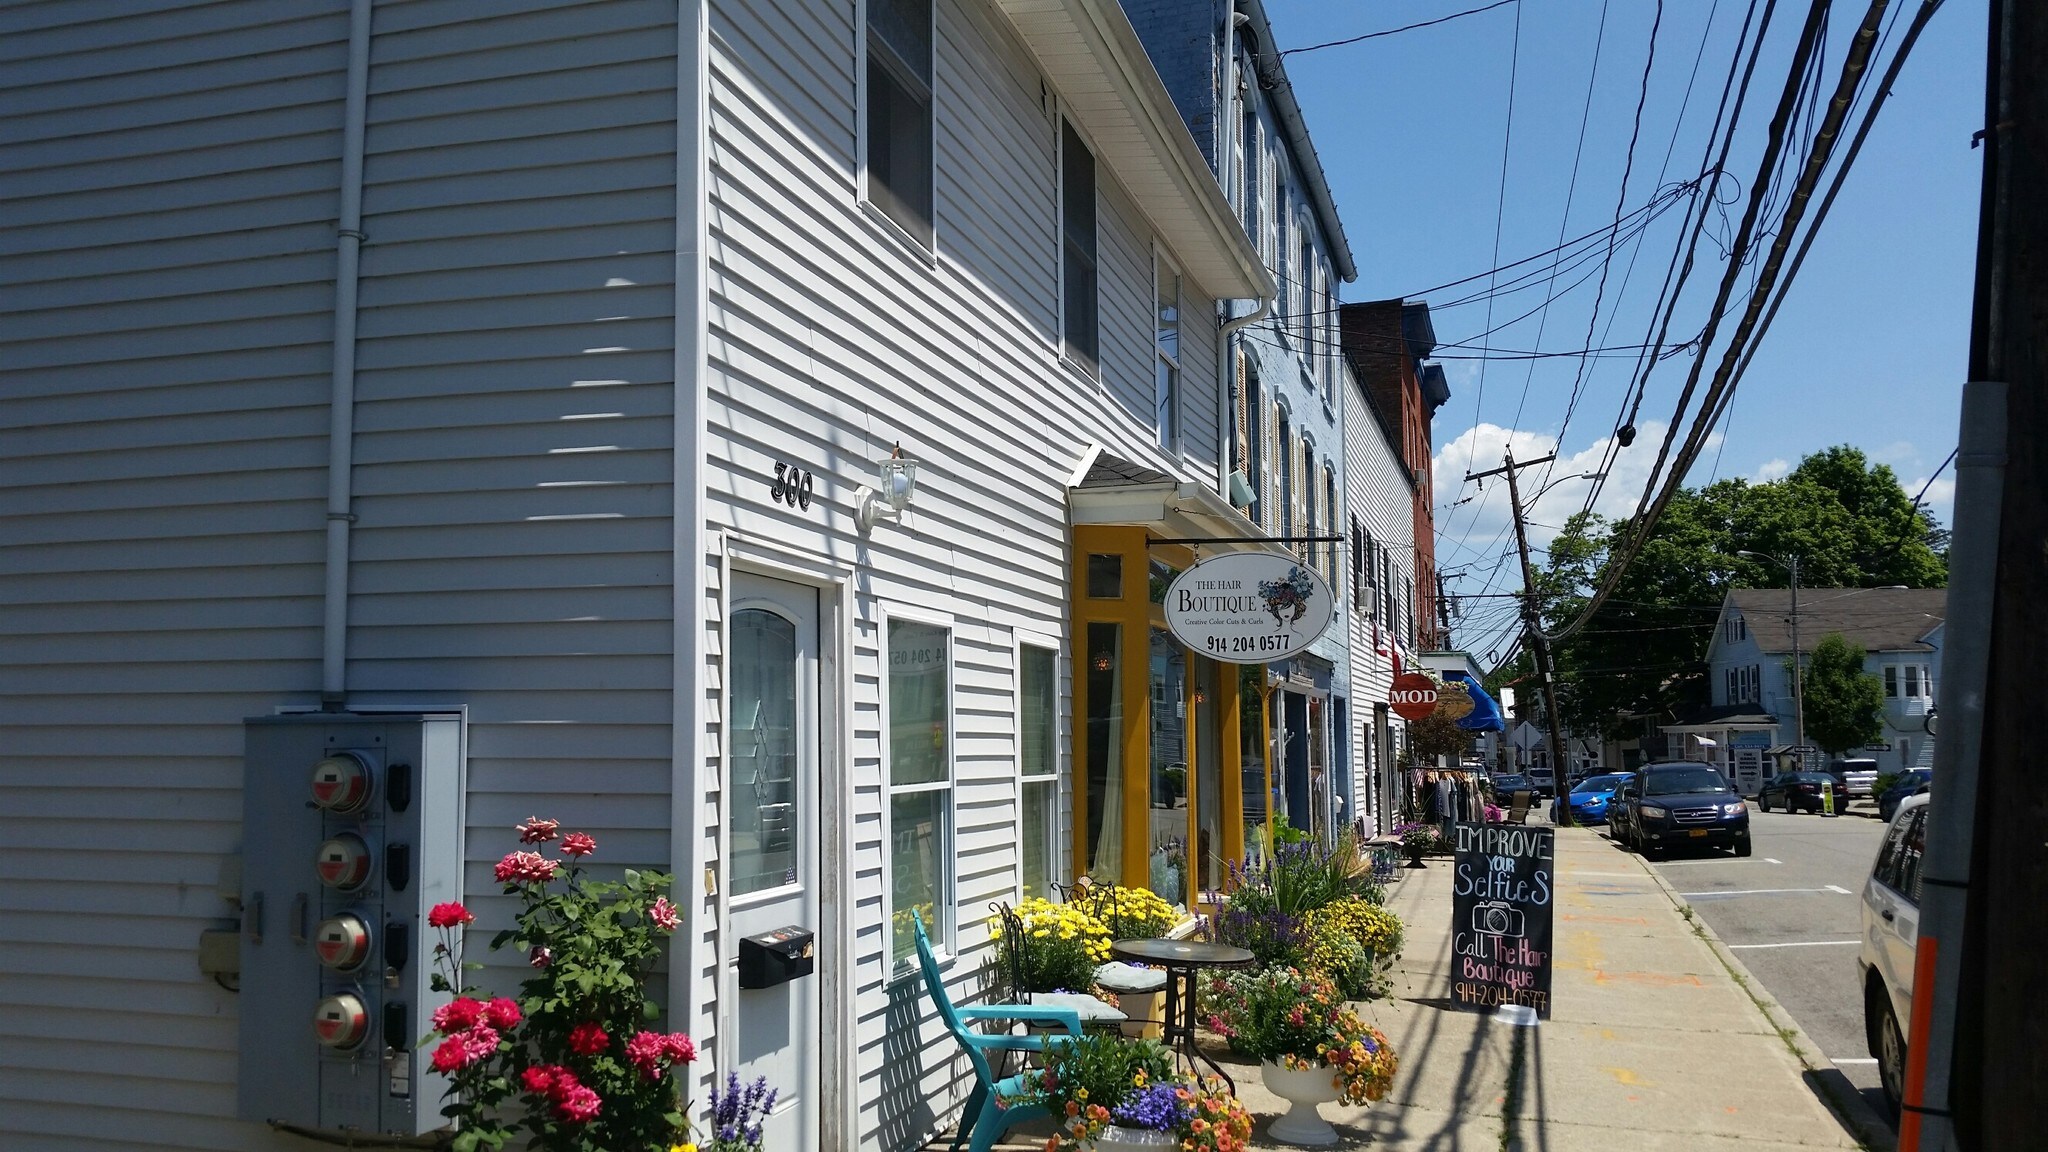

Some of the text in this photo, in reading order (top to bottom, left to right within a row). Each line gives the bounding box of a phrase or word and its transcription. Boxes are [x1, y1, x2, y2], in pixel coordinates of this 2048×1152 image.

[771, 460, 813, 510] 300
[1195, 580, 1242, 590] THE HAIR
[1178, 589, 1257, 614] BOUTIQUE
[1184, 618, 1208, 626] Creative
[1208, 617, 1225, 625] Color
[1226, 617, 1240, 625] Cuts
[1248, 617, 1264, 625] Curls
[1207, 634, 1290, 653] 914 204 0577
[1390, 690, 1437, 704] MOD
[1455, 825, 1554, 860] IMPROVE
[1486, 854, 1516, 873] YOUR
[1455, 932, 1548, 967] Call The Hair
[1463, 956, 1535, 990] Boutique
[1455, 981, 1547, 1012] 914-204-0577
